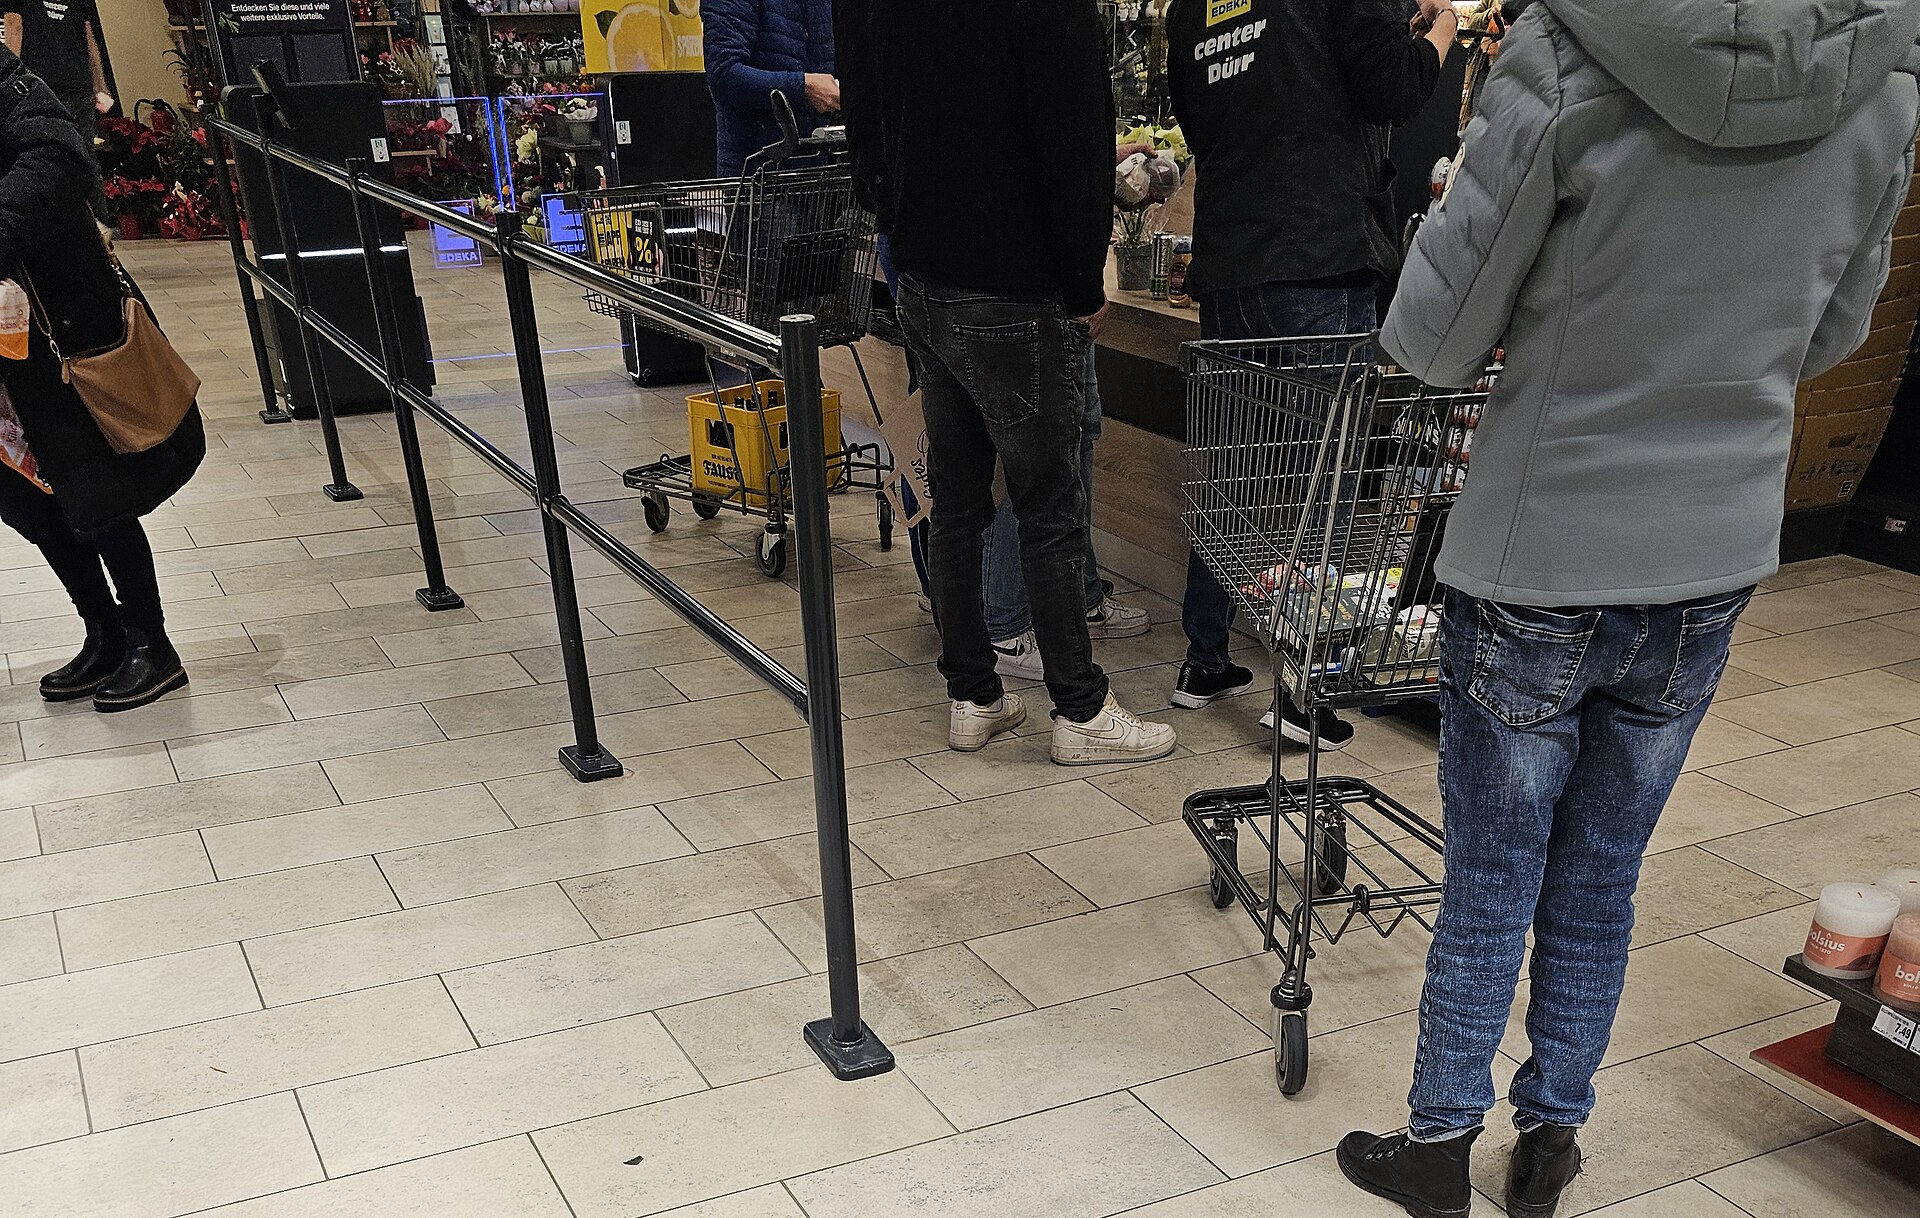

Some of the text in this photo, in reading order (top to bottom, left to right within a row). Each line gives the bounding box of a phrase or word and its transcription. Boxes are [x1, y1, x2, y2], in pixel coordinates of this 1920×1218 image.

[231, 4, 267, 12] Entdecken
[269, 3, 280, 11] Sie
[281, 3, 299, 11] diese
[314, 2, 330, 10] viele
[1212, 0, 1248, 17] EDEKA
[240, 12, 325, 21] weitere exklusive Vorteile.
[1194, 18, 1267, 61] center
[1208, 52, 1255, 84] Dürr
[440, 251, 478, 263] EDEKA
[1810, 929, 1845, 952] olsius
[1895, 964, 1920, 983] bol
